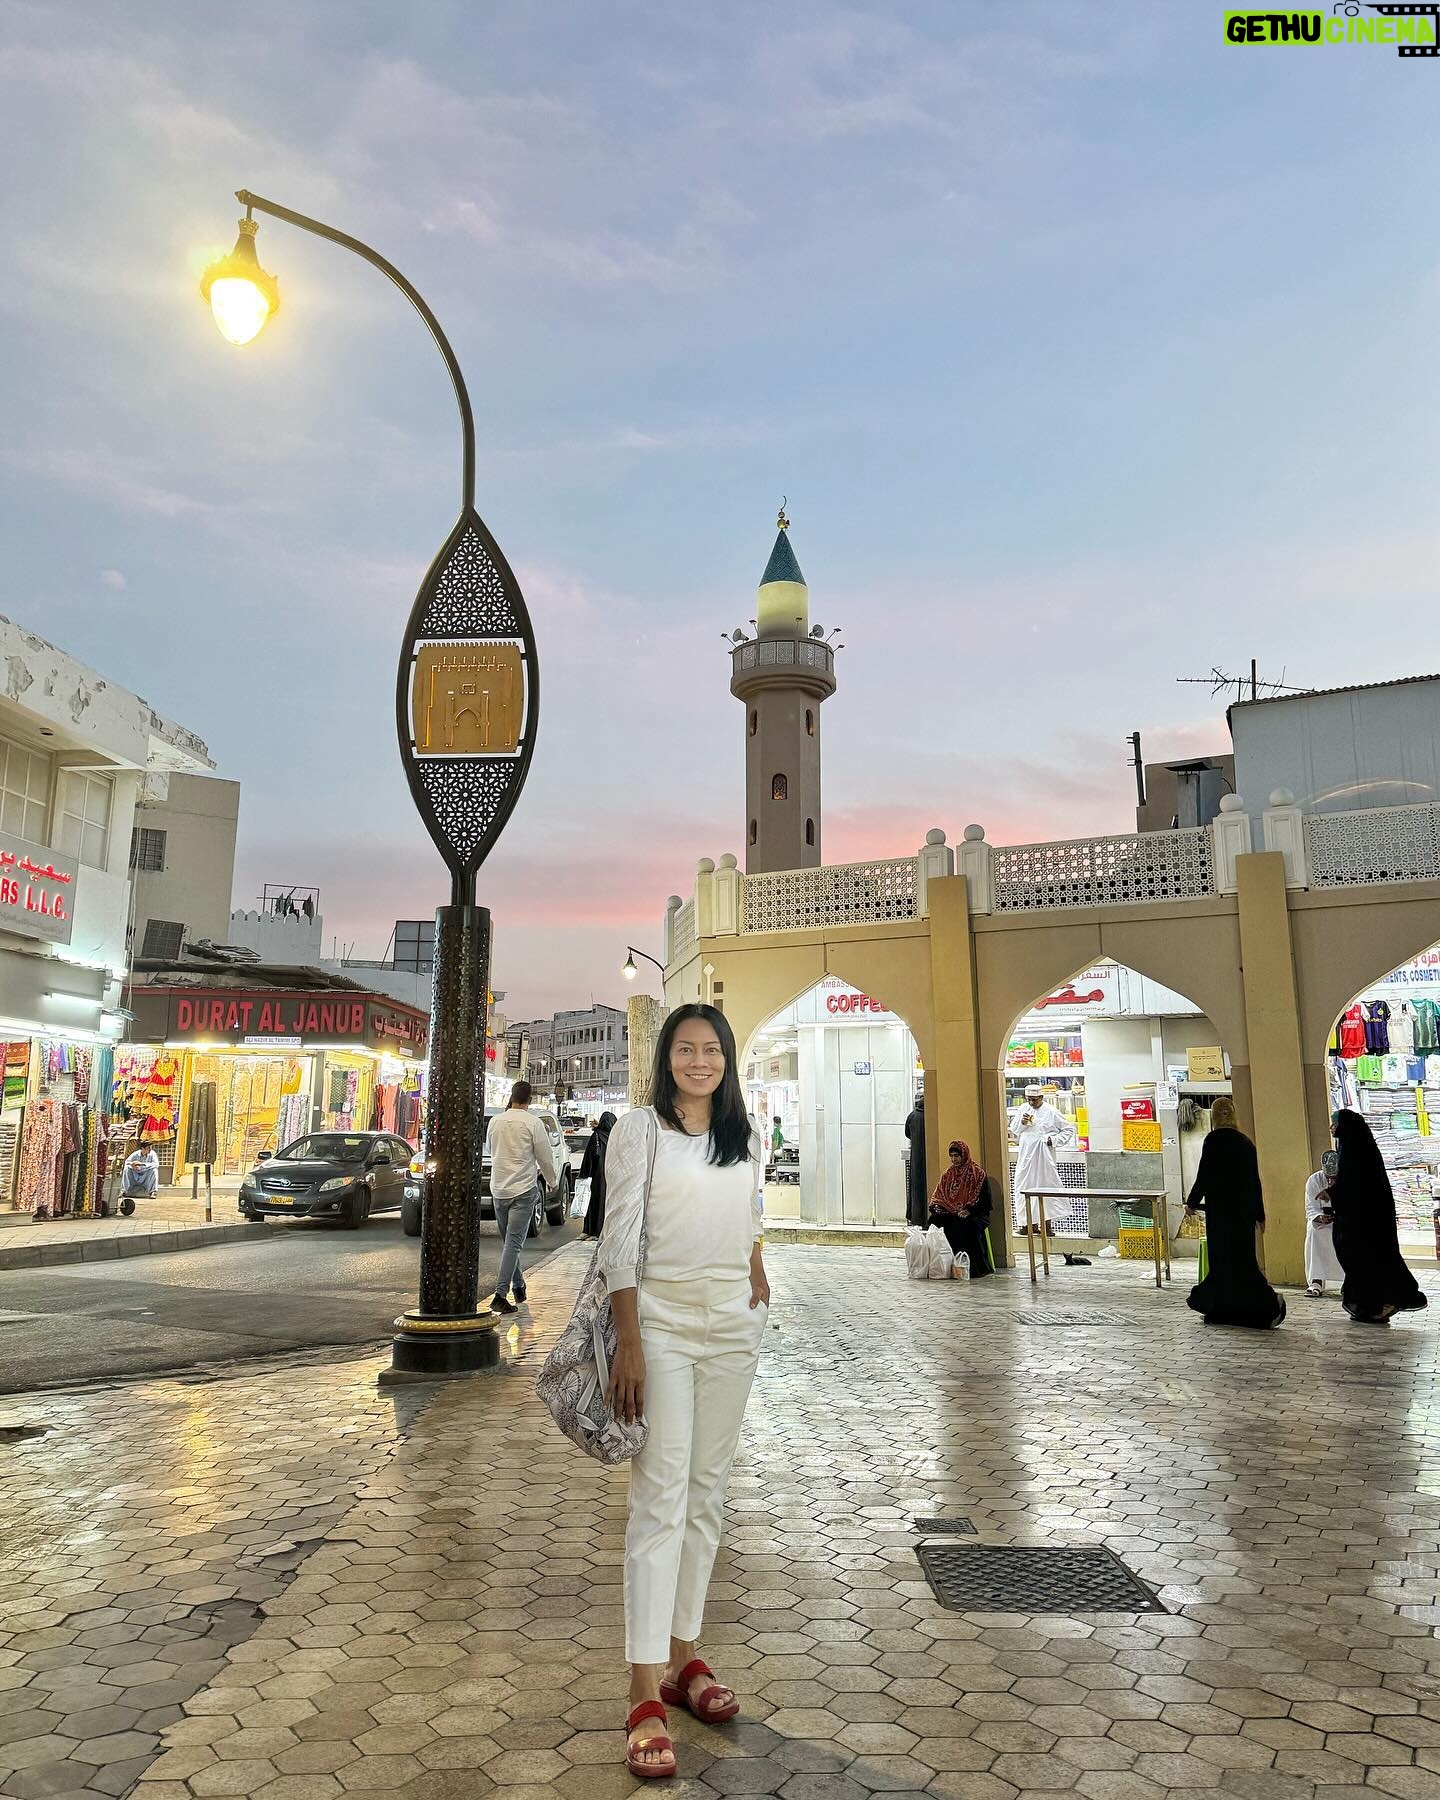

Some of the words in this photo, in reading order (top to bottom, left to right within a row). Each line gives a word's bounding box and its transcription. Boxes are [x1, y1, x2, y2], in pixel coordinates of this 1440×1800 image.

[177, 999, 254, 1033] DURAT
[257, 1001, 286, 1033] AL
[292, 1003, 365, 1035] JANUB
